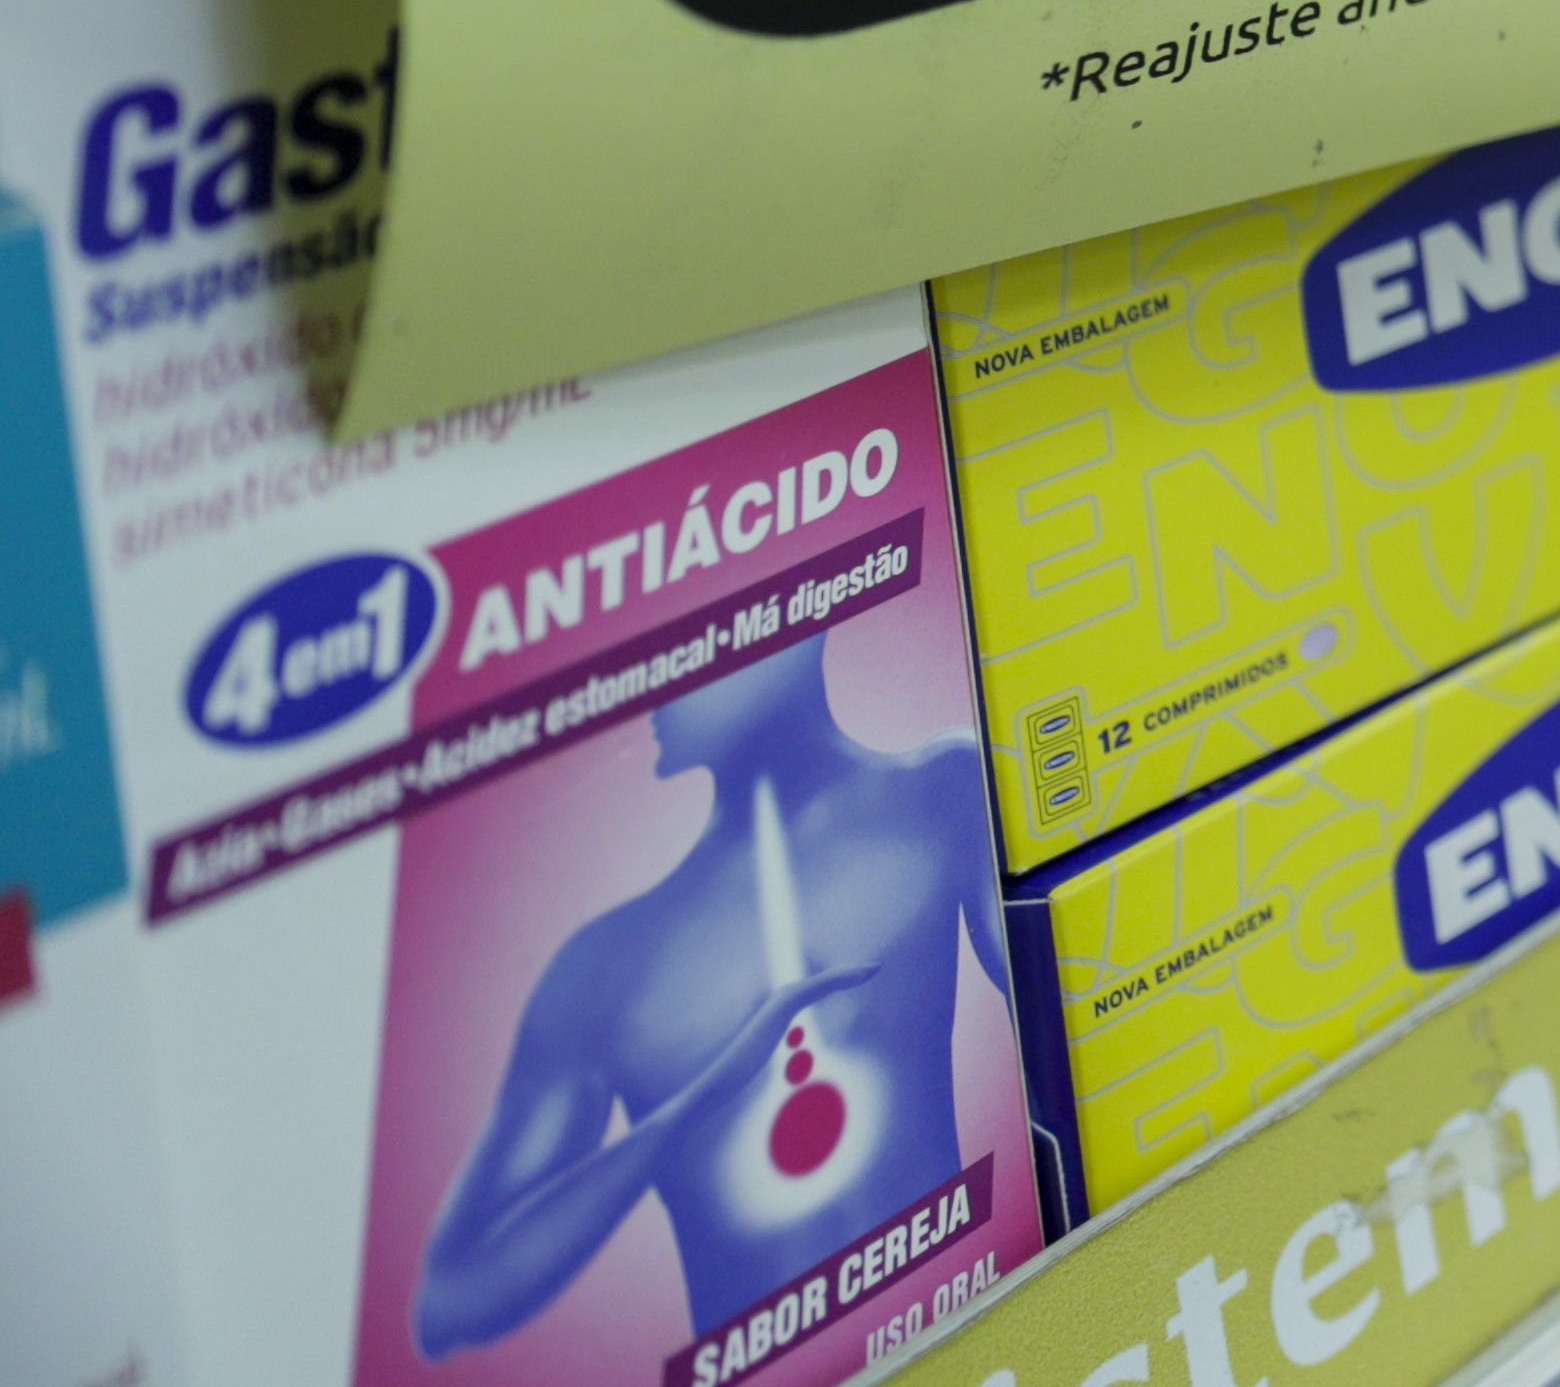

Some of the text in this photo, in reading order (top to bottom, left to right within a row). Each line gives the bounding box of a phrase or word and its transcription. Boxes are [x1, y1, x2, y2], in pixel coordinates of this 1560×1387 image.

[973, 293, 1171, 379] NOVA EMBALAGEM
[458, 427, 901, 672] ANTIÁCIDO
[544, 623, 718, 736] estomacal
[731, 595, 781, 651] Má
[787, 542, 909, 627] digestão
[1097, 651, 1290, 755] 12 COMPRIMIDOS
[1092, 905, 1274, 1020] NOVA EMBALAGEM
[690, 1182, 971, 1387] SABOR CEREJA
[865, 1249, 1001, 1368] USO ORAL
